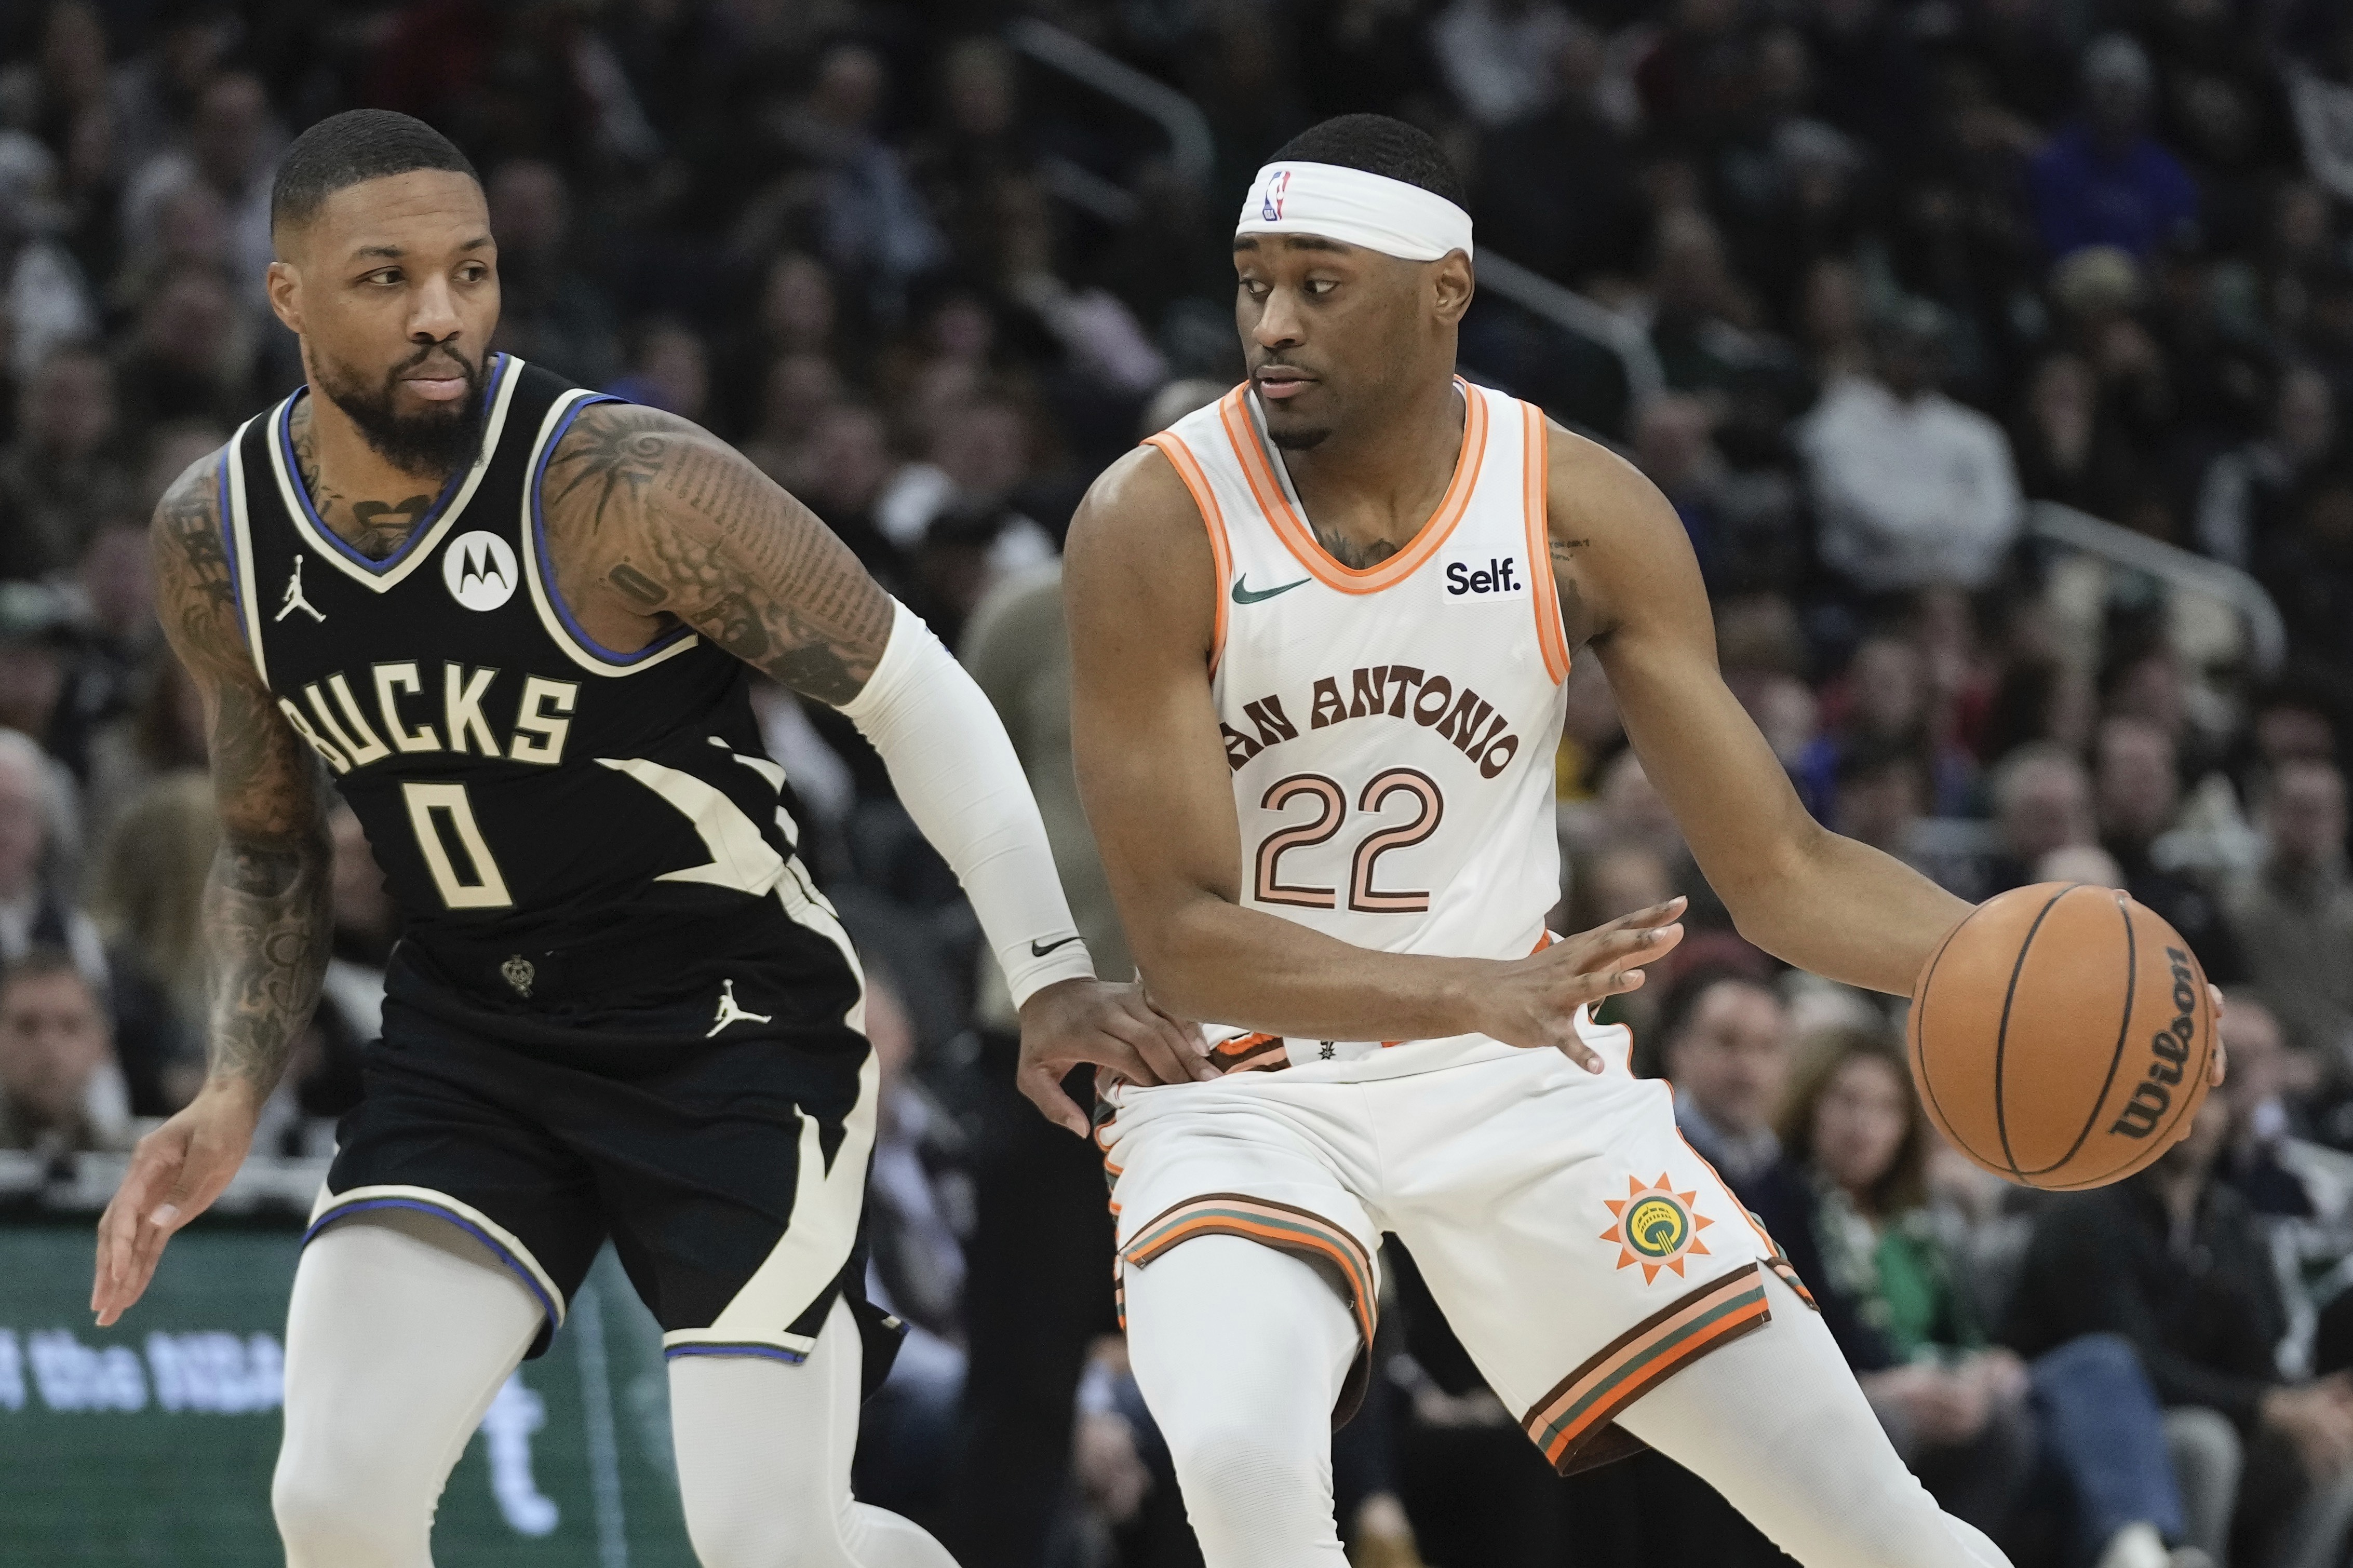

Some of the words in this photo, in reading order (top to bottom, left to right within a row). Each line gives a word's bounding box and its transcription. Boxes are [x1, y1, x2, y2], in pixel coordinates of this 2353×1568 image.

[1446, 557, 1521, 595] Self.
[278, 659, 582, 776] BUCKS
[1219, 694, 1300, 774] AN
[1311, 665, 1519, 779] ANTONIO
[401, 780, 516, 909] 0
[1254, 767, 1444, 912] 22
[2108, 946, 2196, 1140] Wilson
